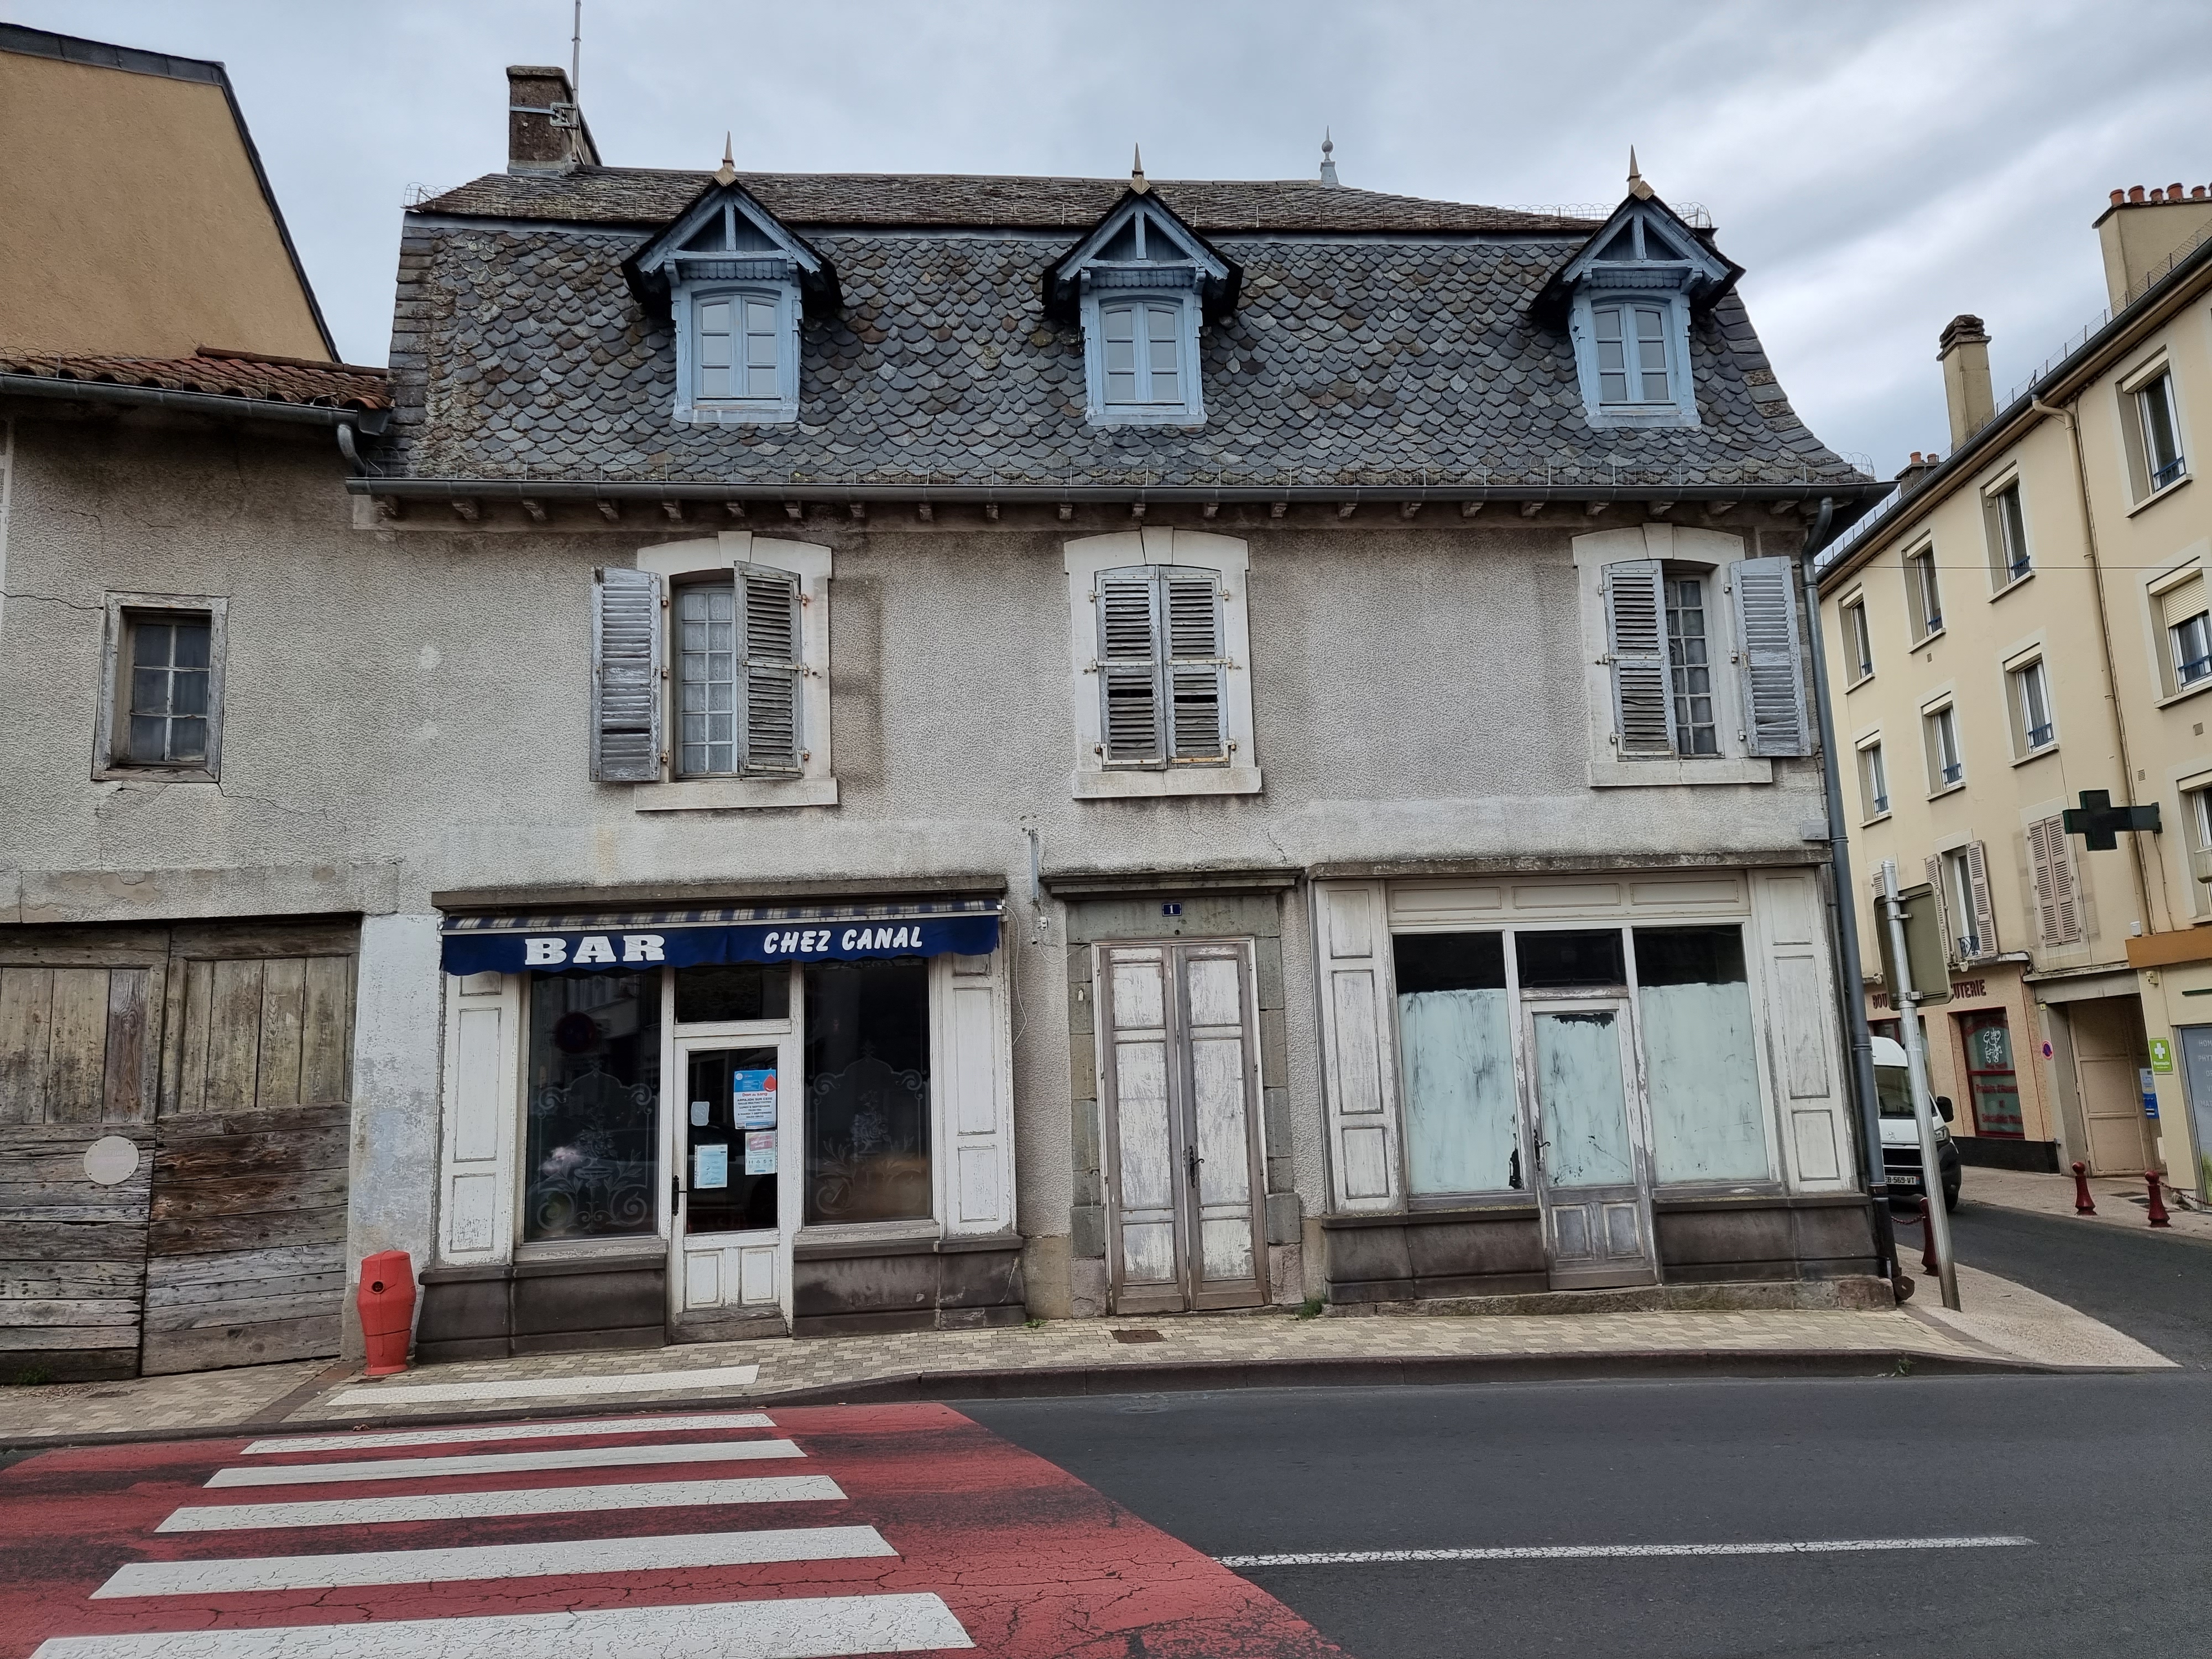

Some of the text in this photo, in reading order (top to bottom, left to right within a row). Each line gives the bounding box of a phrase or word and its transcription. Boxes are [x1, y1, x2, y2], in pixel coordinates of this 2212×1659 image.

[1170, 905, 1174, 914] 1
[525, 935, 665, 966] BAR
[764, 926, 922, 954] CHEZ CANAL
